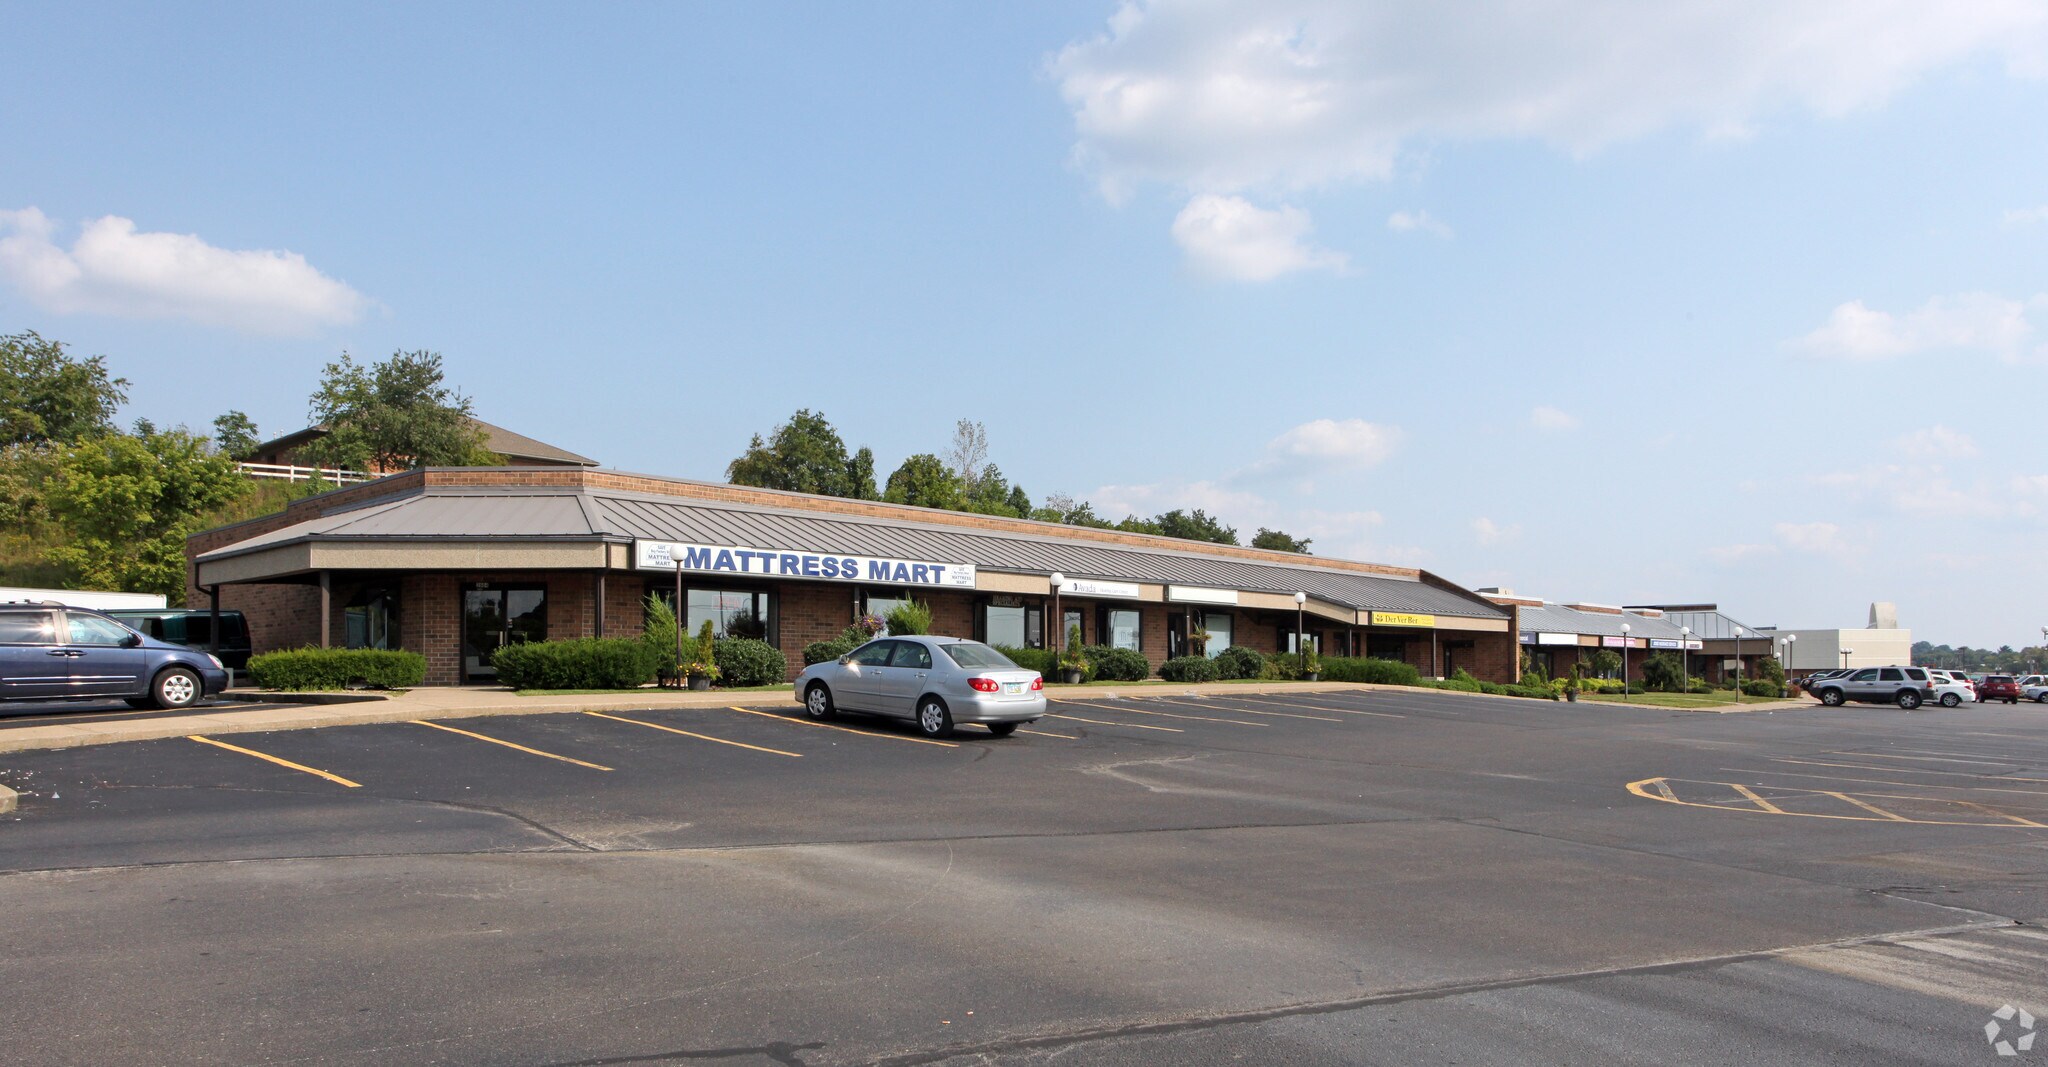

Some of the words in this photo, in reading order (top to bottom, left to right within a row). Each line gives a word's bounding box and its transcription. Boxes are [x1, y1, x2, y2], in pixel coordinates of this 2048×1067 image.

[684, 547, 858, 578] MATTRESS
[869, 561, 945, 583] MART
[1078, 583, 1096, 593] Avada
